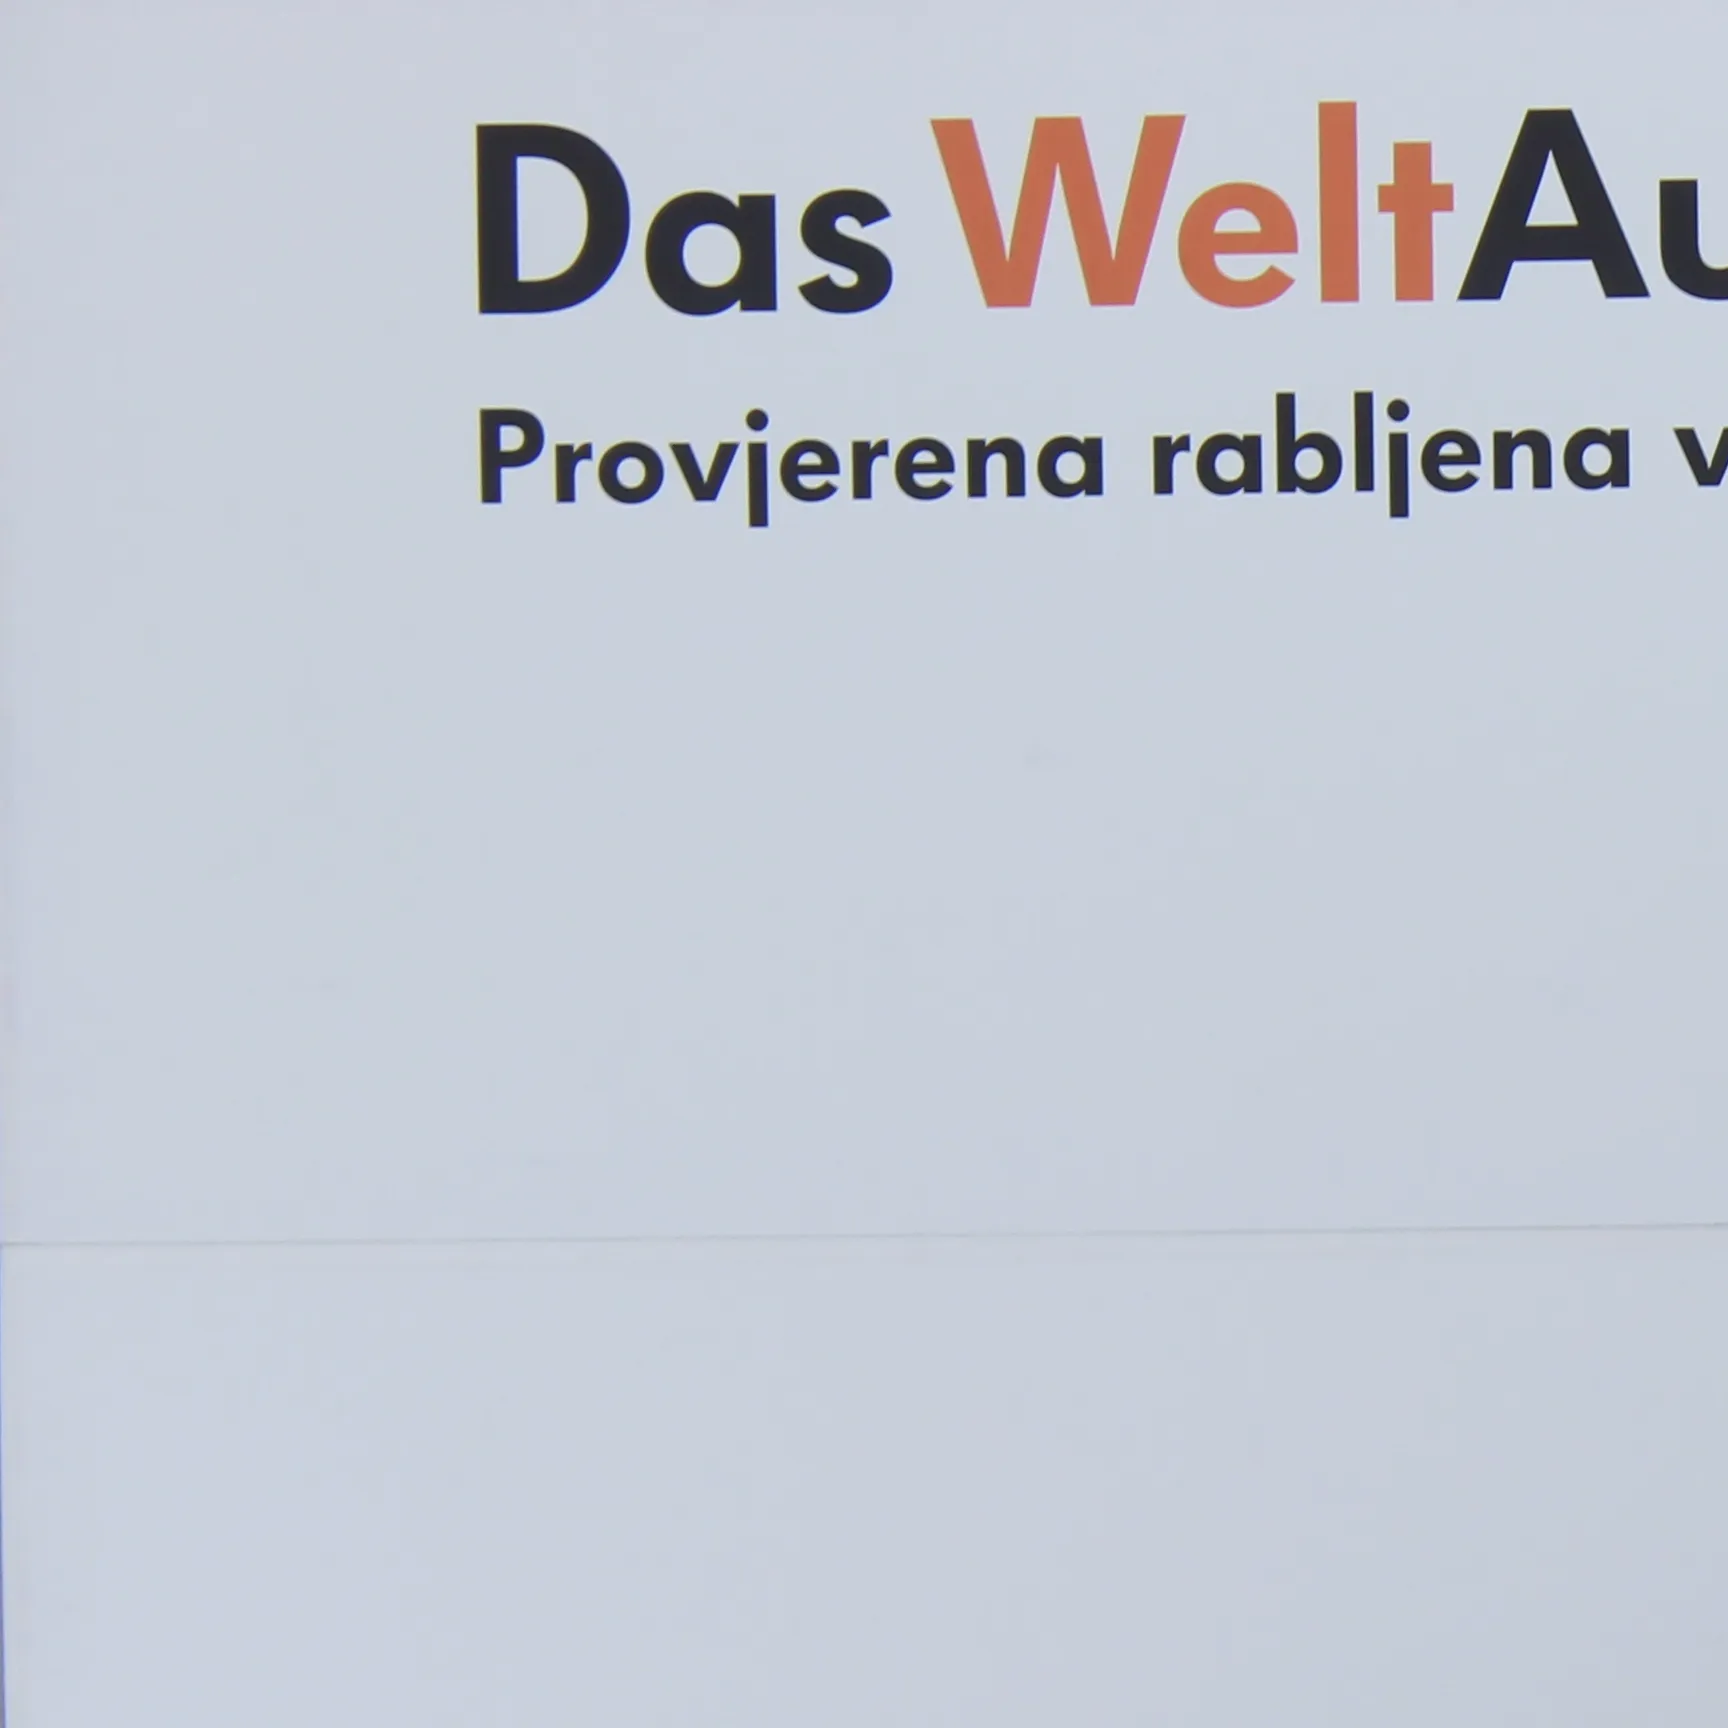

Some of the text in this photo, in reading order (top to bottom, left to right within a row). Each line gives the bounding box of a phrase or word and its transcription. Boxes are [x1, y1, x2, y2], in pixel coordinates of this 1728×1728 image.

[475, 122, 893, 317] Das
[479, 408, 1104, 528] Provjerena
[1152, 390, 1631, 519] rabljena
